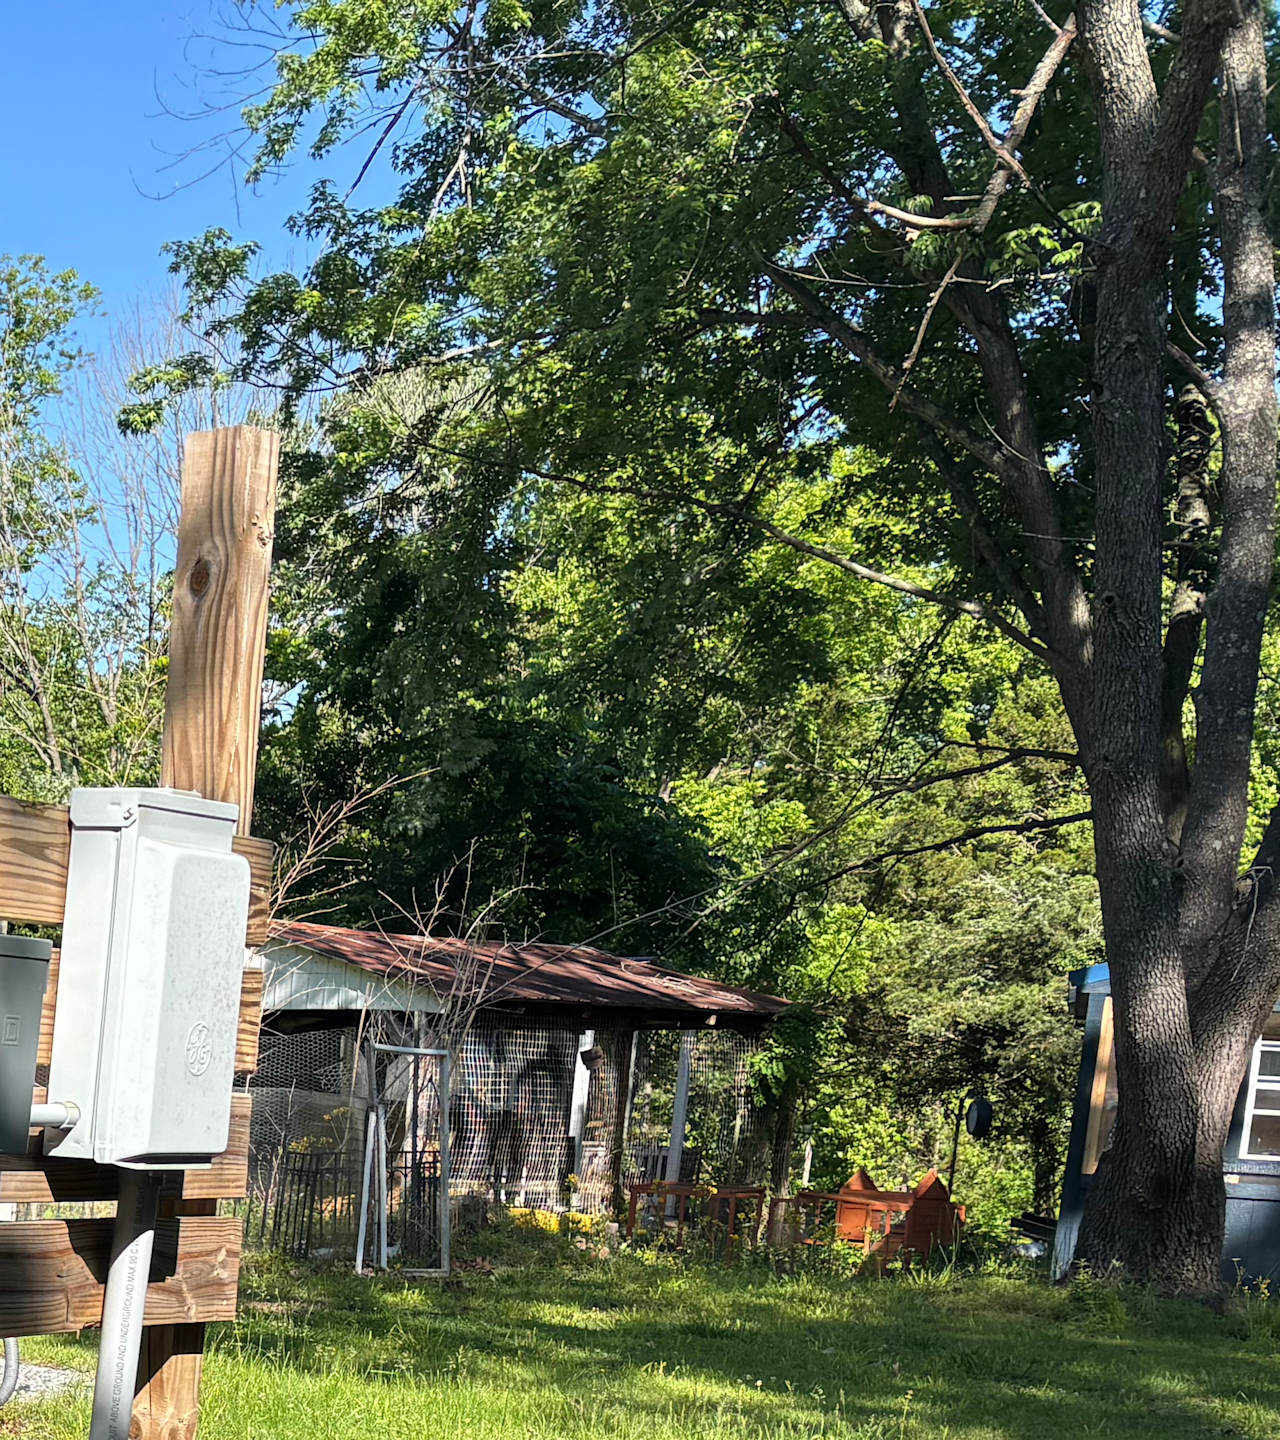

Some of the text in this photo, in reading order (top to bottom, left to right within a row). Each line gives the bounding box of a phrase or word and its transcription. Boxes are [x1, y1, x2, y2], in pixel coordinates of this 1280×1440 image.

[128, 1265, 136, 1282] MAX
[120, 1283, 134, 1343] UNDERGROUND
[118, 1344, 126, 1361] AND
[113, 1361, 124, 1395] GROUND
[111, 1395, 120, 1422] ABOVE
